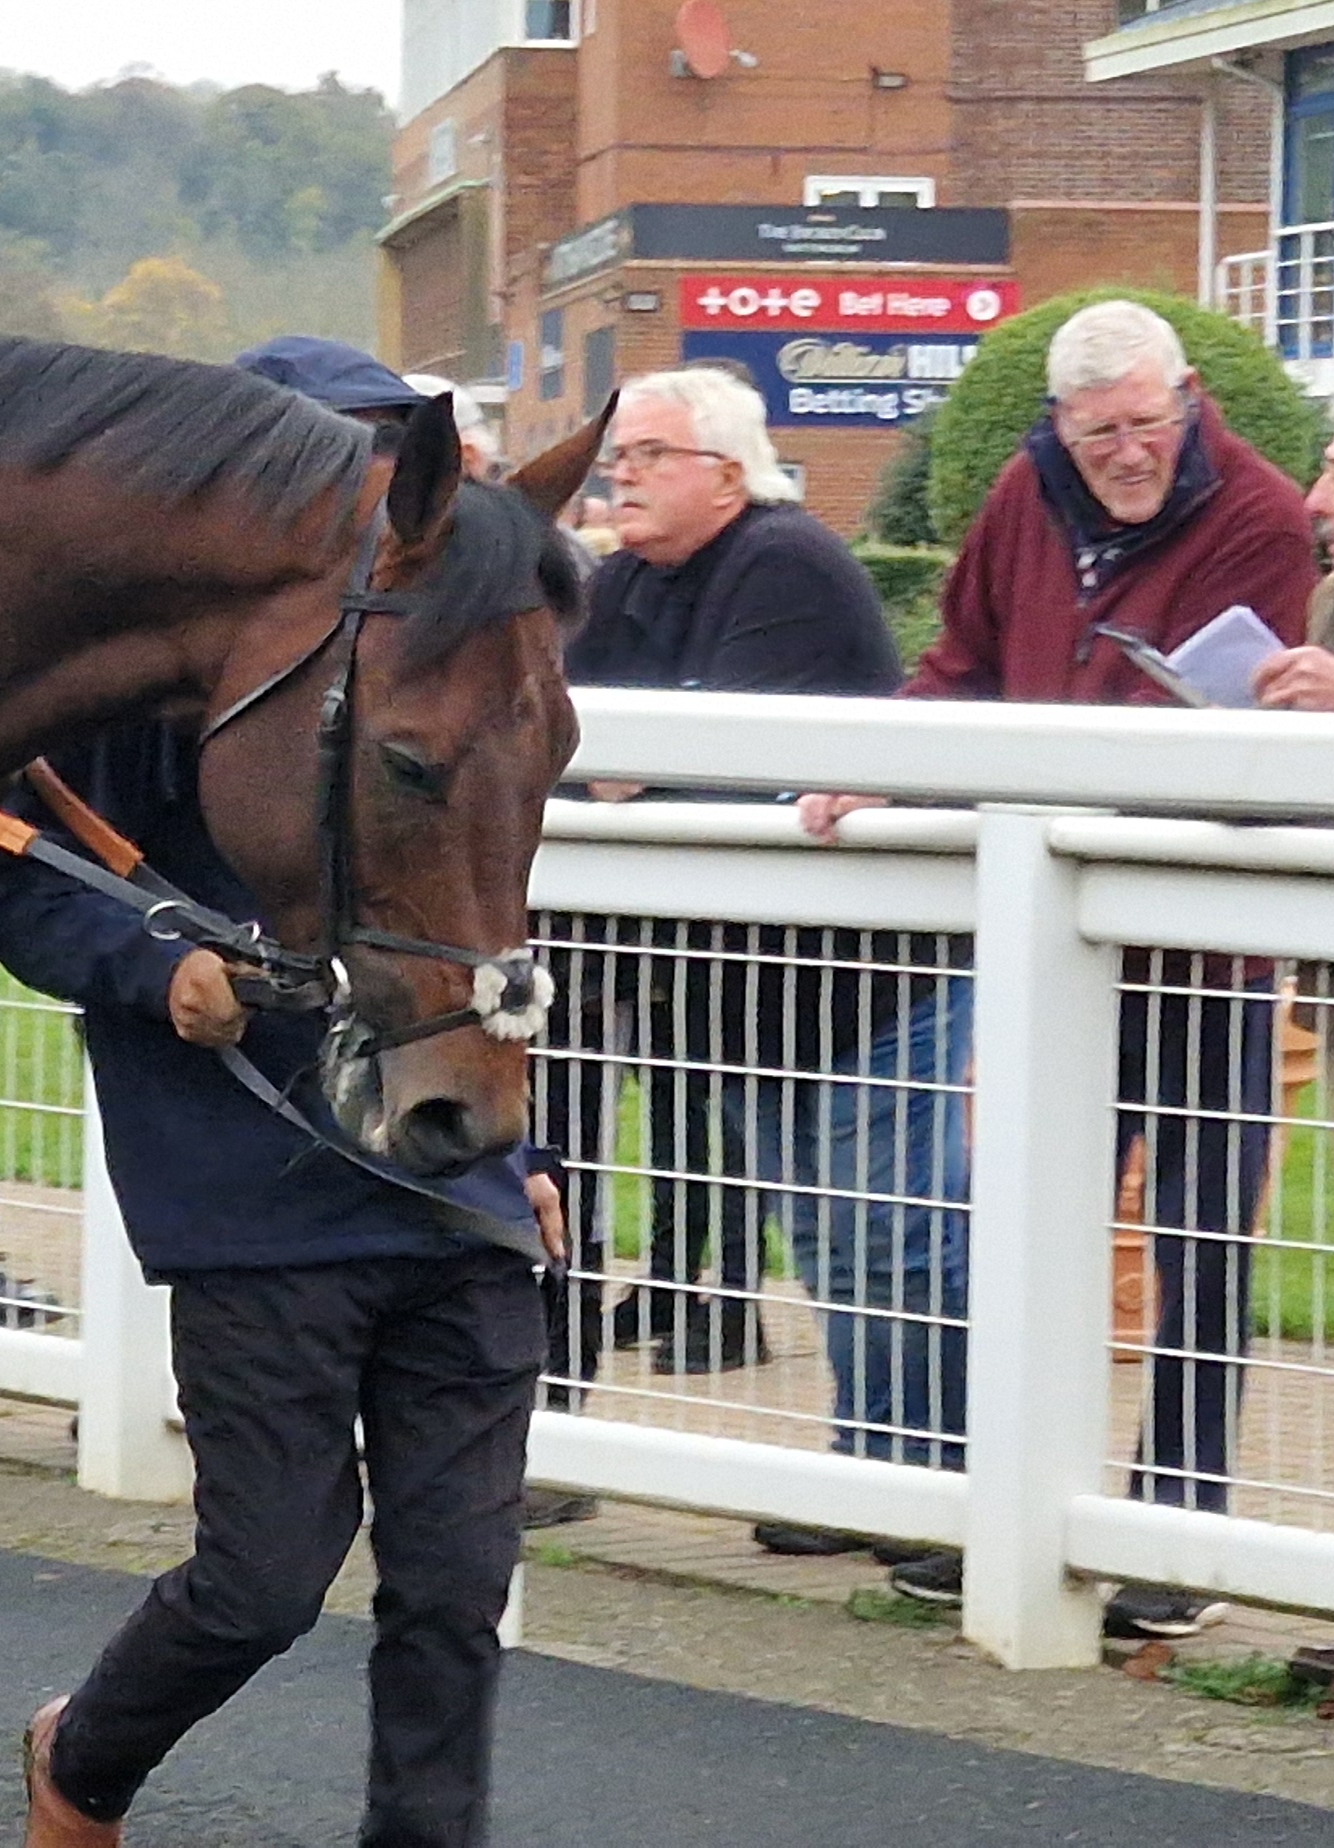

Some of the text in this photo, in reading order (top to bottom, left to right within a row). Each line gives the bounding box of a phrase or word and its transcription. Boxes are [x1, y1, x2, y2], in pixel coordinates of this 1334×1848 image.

[838, 291, 884, 316] Bet
[886, 292, 952, 317] Here
[788, 387, 900, 420] Betting
